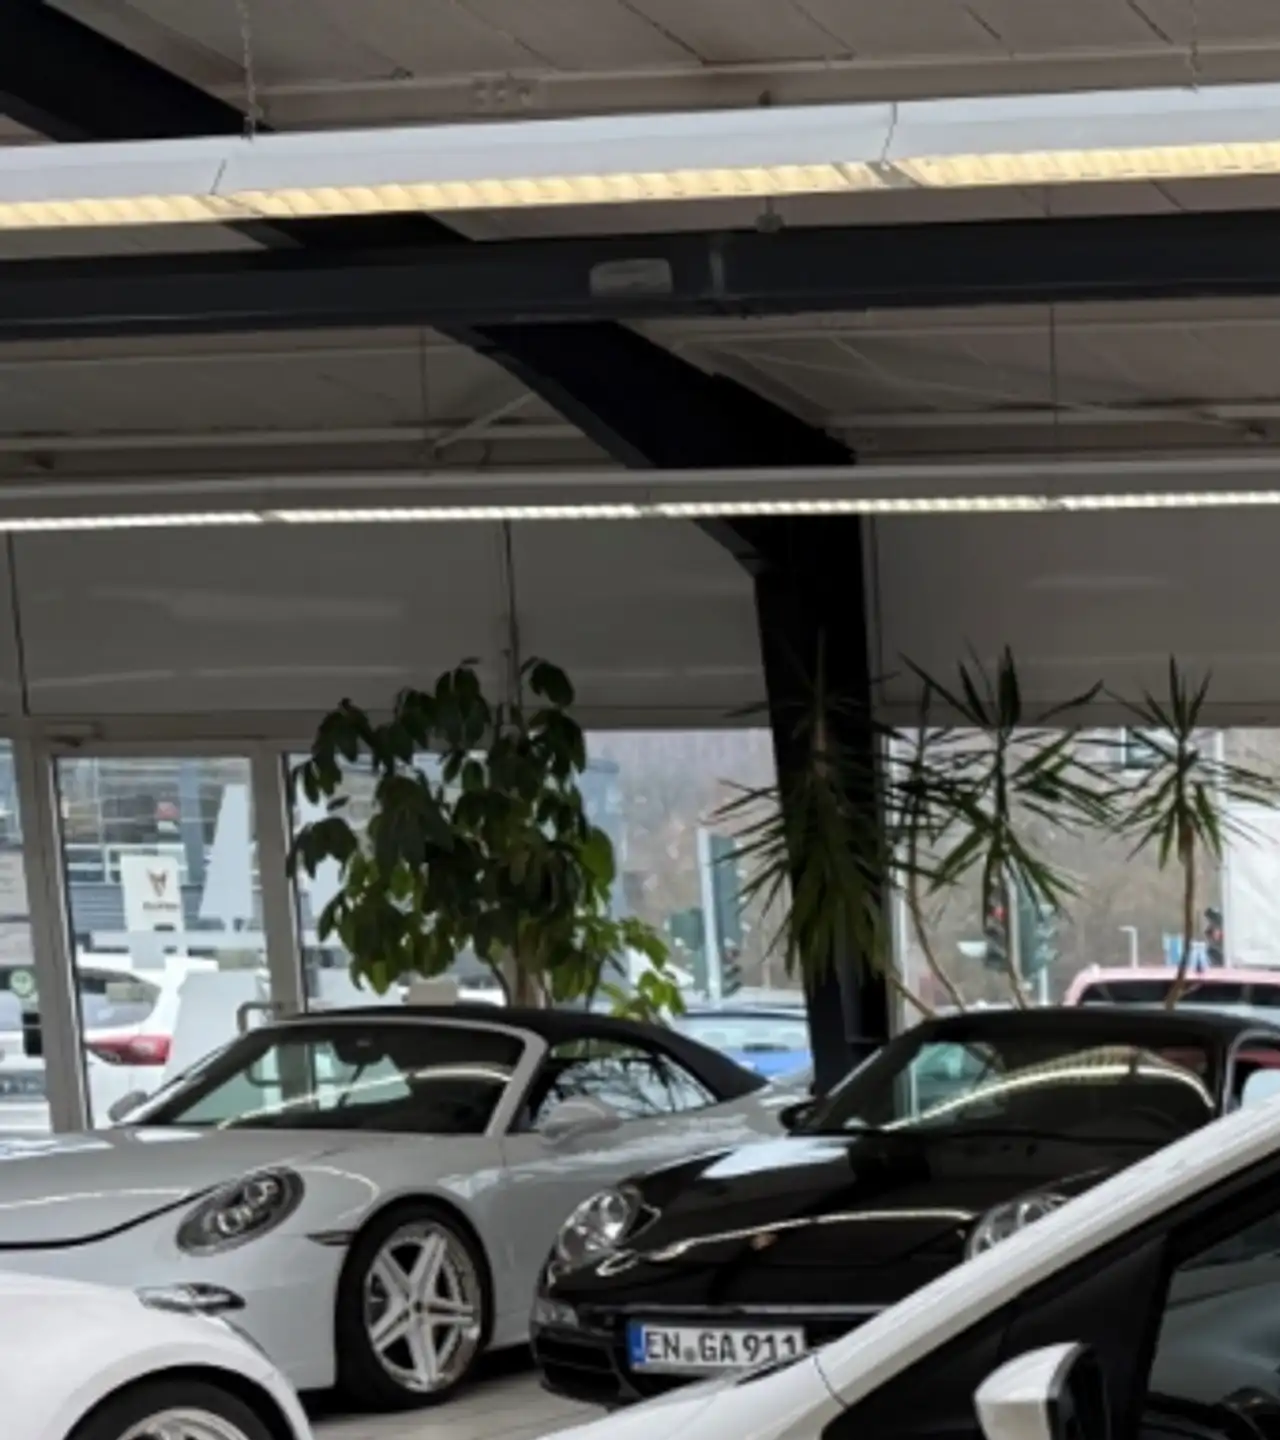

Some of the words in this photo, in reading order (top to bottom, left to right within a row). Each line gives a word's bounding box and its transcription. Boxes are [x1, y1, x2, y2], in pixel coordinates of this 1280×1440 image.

[645, 1331, 681, 1361] EN
[699, 1333, 736, 1363] GA
[743, 1334, 798, 1363] 911
